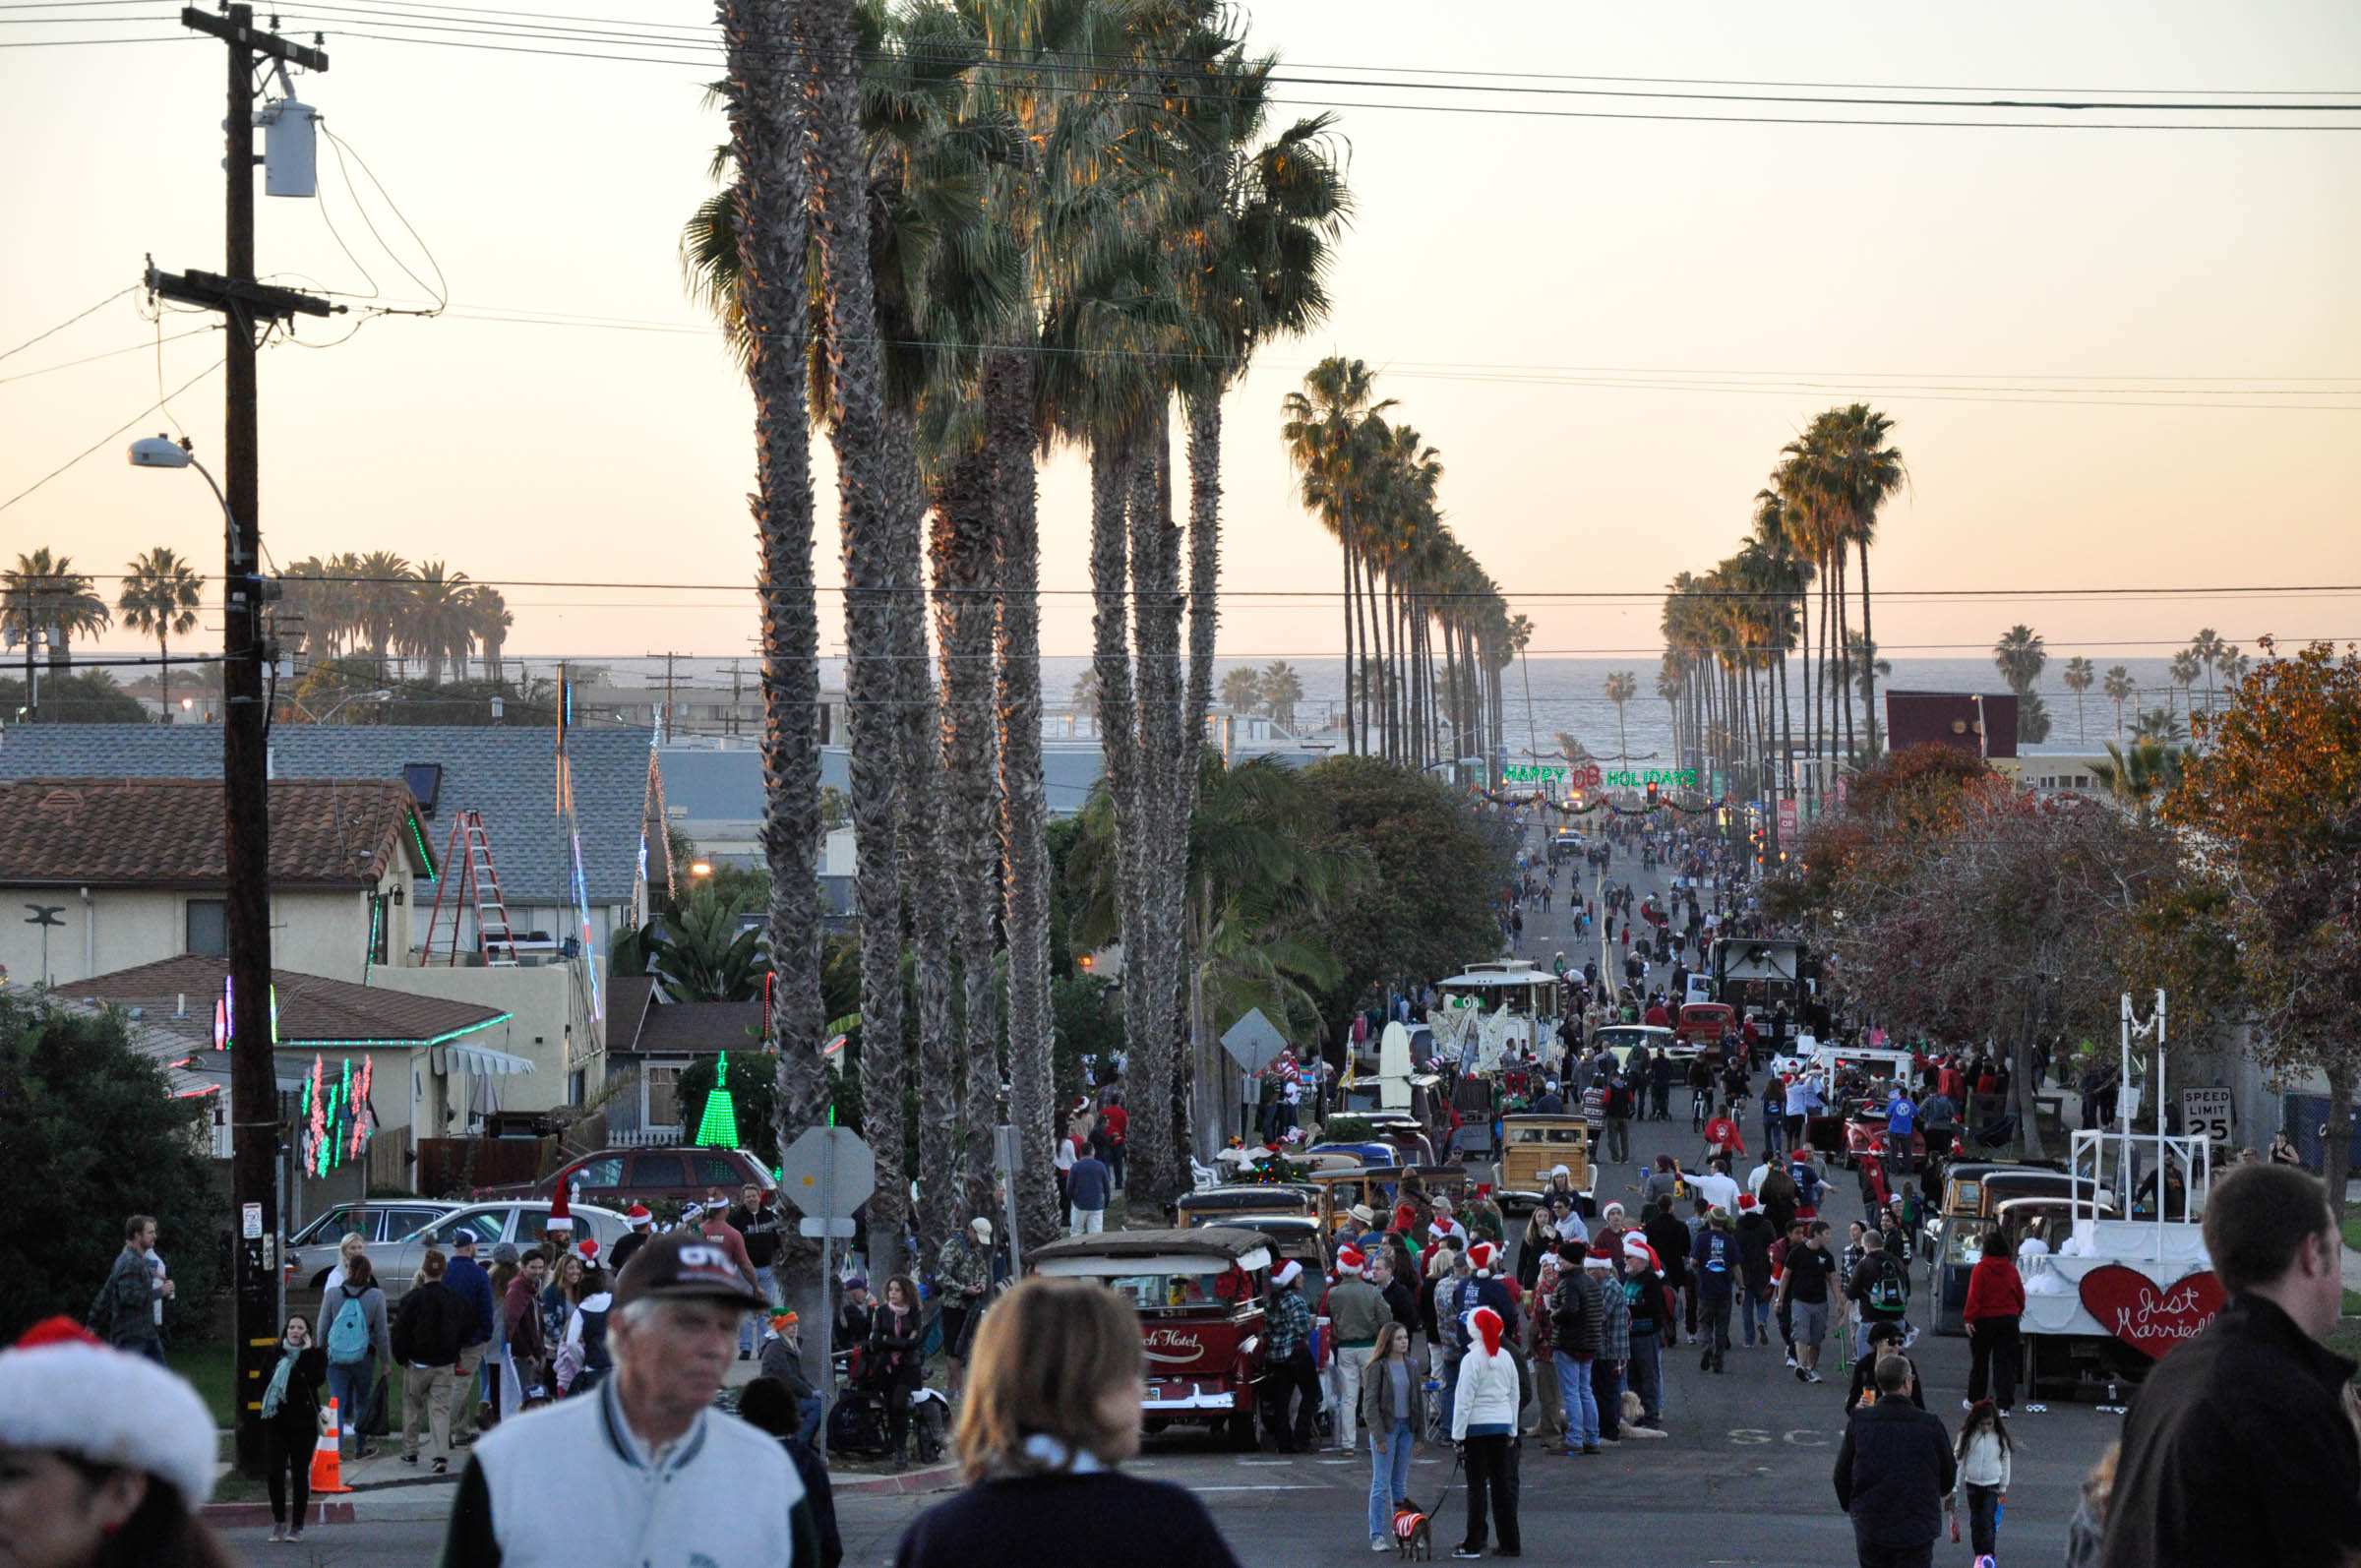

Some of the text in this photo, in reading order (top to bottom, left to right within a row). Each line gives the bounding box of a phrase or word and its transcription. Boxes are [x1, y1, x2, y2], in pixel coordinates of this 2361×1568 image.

[1504, 764, 1567, 783] HAPPY
[1574, 764, 1601, 787] OB
[1607, 768, 1700, 787] HOLIDAYS
[2185, 1092, 2229, 1102] SPEED
[2190, 1105, 2225, 1116] LIMIT
[2189, 1119, 2228, 1140] 25
[2138, 1287, 2200, 1322] Just
[1141, 1329, 1198, 1348] ch Hotel
